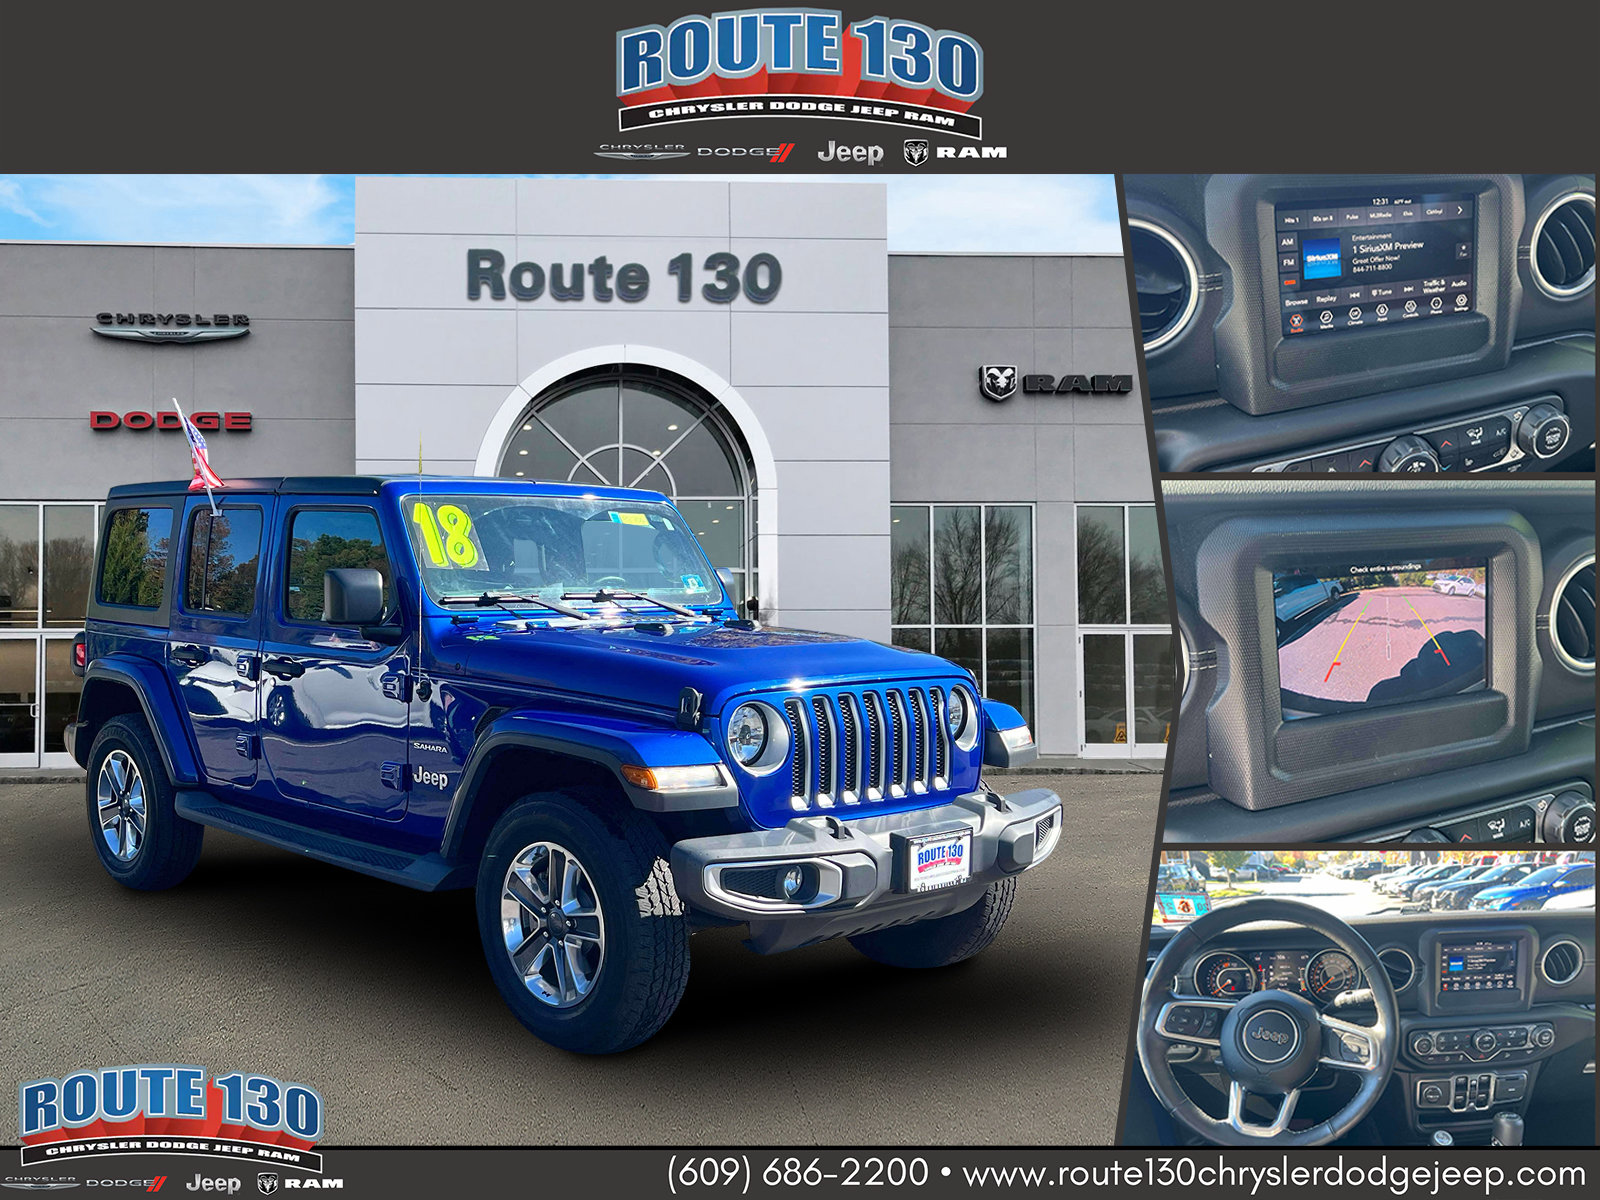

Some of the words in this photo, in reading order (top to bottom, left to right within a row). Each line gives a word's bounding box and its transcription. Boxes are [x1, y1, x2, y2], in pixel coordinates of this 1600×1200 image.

[1281, 238, 1294, 246] AM
[1351, 233, 1392, 242] Entertainment
[1352, 245, 1357, 254] 1
[1359, 243, 1393, 254] SiriusXM
[1394, 241, 1424, 250] Preview
[1352, 257, 1369, 265] Great
[467, 248, 650, 302] Route
[668, 251, 783, 303] 130
[1285, 299, 1308, 307] Browse
[1316, 295, 1337, 303] Replay
[96, 312, 250, 326] CHRYSLER
[1022, 374, 1134, 394] RAM
[89, 410, 253, 431] DODGE
[412, 502, 480, 568] 18
[1350, 566, 1369, 574] Check
[1369, 565, 1386, 573] entire
[1386, 562, 1422, 571] surroundings
[413, 742, 448, 754] SAHARA
[412, 766, 448, 790] Jeep
[1519, 818, 1531, 829] A/C
[917, 845, 946, 865] ROUTE
[948, 844, 964, 858] 130
[1251, 1026, 1289, 1045] Jeep
